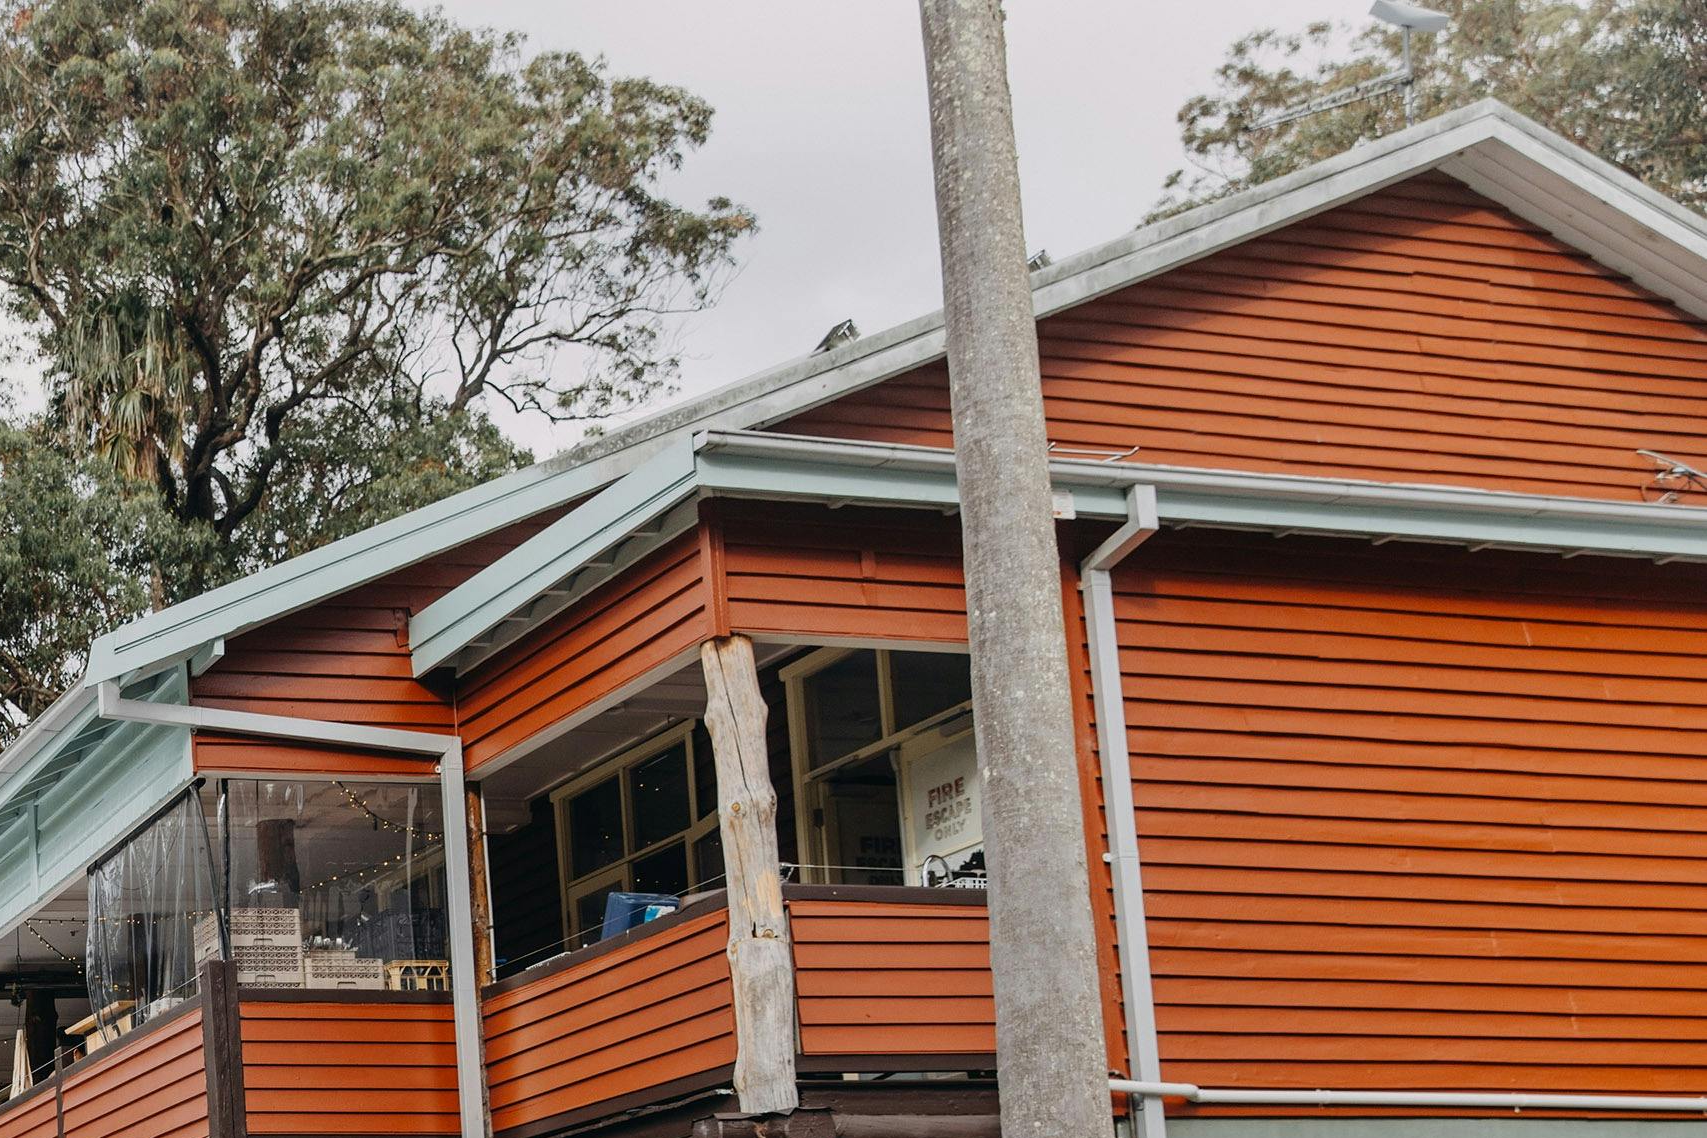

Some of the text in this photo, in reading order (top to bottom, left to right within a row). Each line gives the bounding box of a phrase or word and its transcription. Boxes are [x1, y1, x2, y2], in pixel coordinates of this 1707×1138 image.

[927, 776, 965, 808] FIRE
[925, 797, 971, 830] ESCAPE
[934, 818, 966, 841] ONLY
